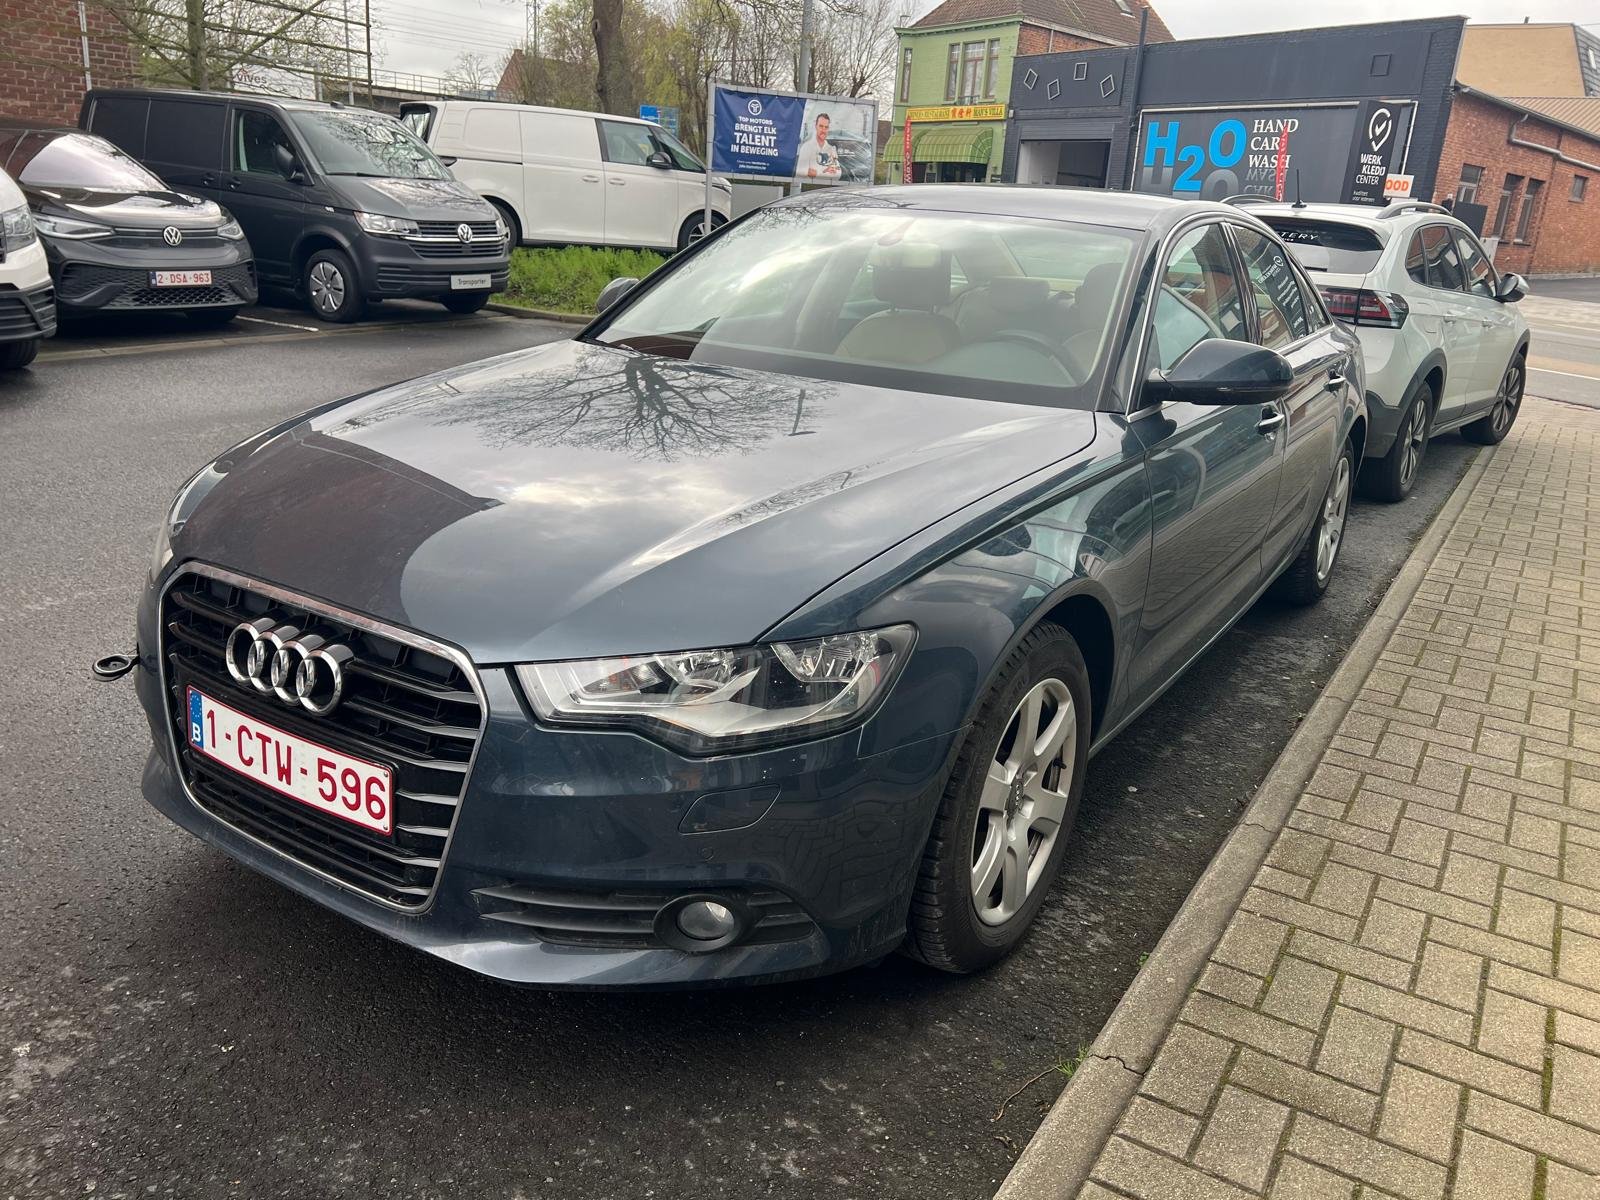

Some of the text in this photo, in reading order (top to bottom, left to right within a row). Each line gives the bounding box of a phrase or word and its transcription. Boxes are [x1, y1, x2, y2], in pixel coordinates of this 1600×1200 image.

[735, 123, 777, 134] BRENGT ELK
[1252, 118, 1299, 133] HAND
[734, 132, 777, 147] TALENT
[1250, 136, 1280, 151] CAR
[731, 144, 779, 157] IN BEWEGING
[1144, 118, 1247, 191] H2O
[1361, 153, 1382, 165] WERK
[1355, 174, 1380, 185] CENTER
[1385, 179, 1409, 191] OOD
[157, 273, 210, 284] 2-DSA-963
[192, 709, 386, 820] B 1-CTW-596
